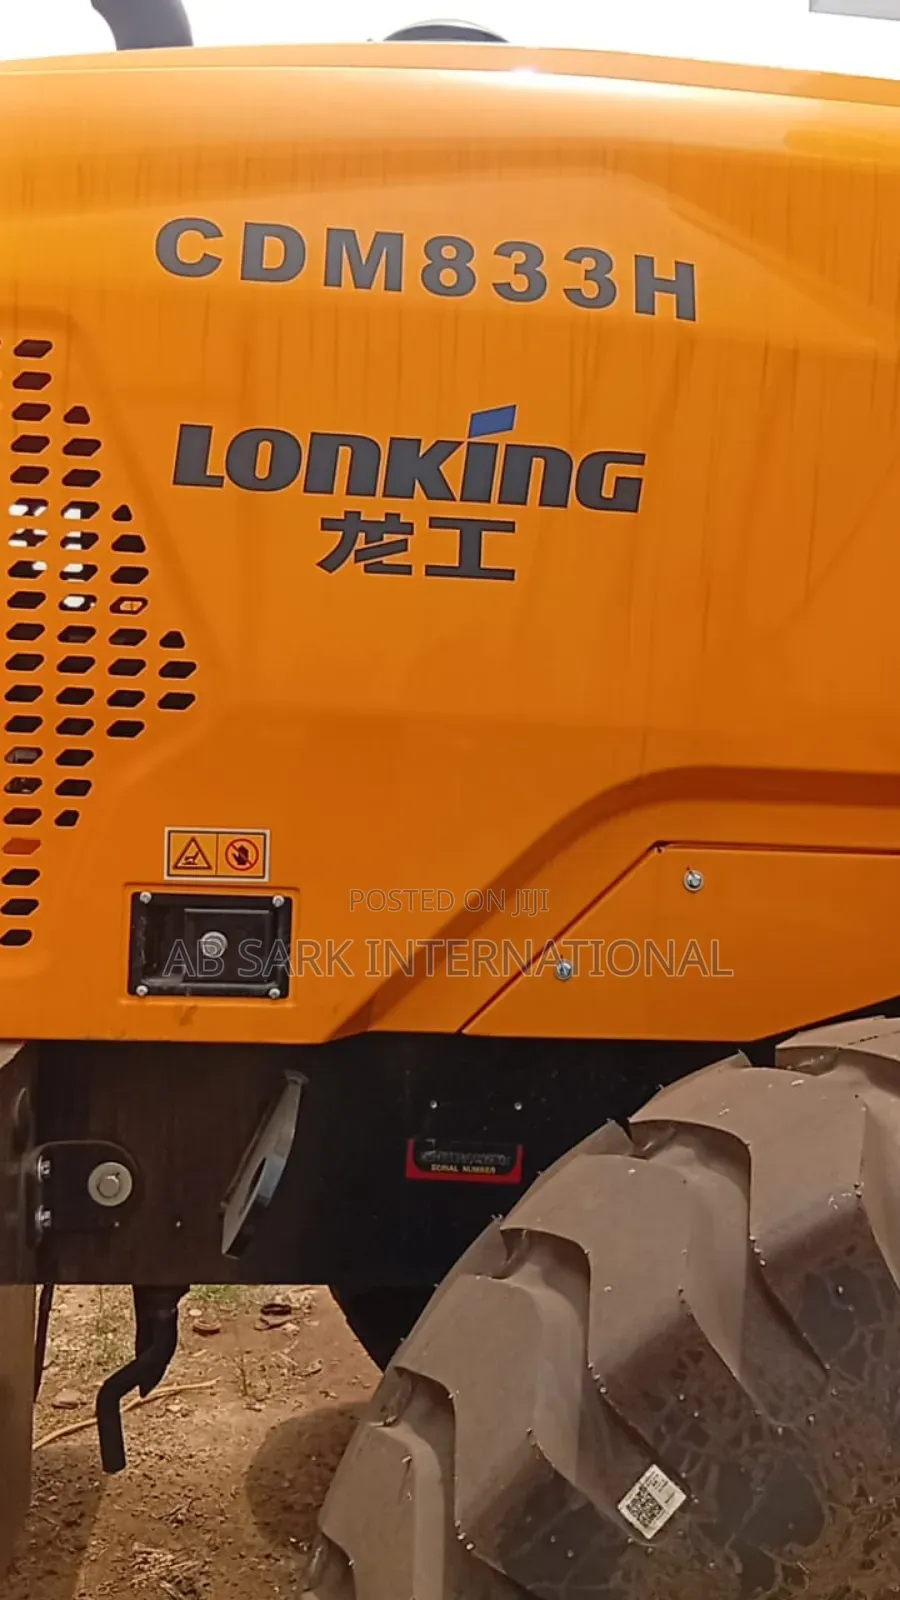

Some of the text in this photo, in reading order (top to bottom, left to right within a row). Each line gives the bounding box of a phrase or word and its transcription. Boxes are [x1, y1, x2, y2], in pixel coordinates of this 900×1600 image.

[155, 216, 698, 322] CDM833H
[316, 510, 517, 581] 龙工
[431, 1163, 496, 1174] SERIAL NUMBER
